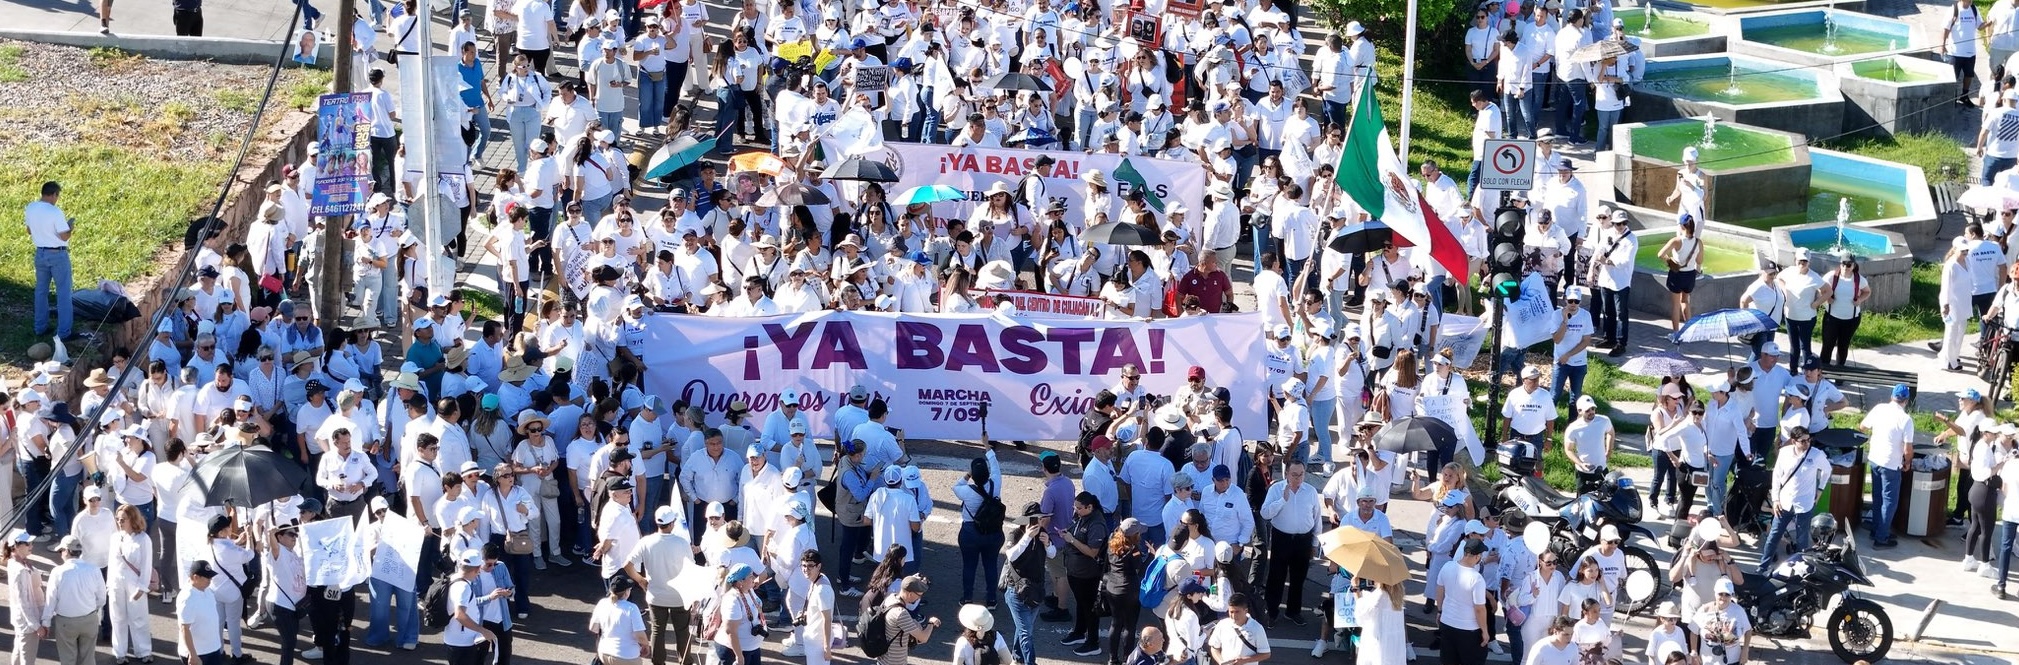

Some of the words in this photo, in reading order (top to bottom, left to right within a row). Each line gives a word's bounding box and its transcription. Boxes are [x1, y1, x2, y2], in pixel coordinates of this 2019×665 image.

[355, 132, 370, 141] 20
[940, 153, 980, 173] ¡YA
[985, 155, 1079, 179] BASA!
[1483, 177, 1496, 185] SOLO
[1511, 178, 1530, 186] FLECHA
[1015, 296, 1026, 311] DEL
[1027, 297, 1050, 313] CENTRO
[1053, 299, 1061, 314] DE
[743, 320, 869, 380] ¡YA
[896, 321, 1165, 375] BASTA!
[1268, 366, 1286, 375] 7/09
[918, 388, 992, 401] MARCHA
[930, 407, 981, 422] 7/09
[1514, 494, 1530, 511] 0894
[326, 589, 339, 600] SM
